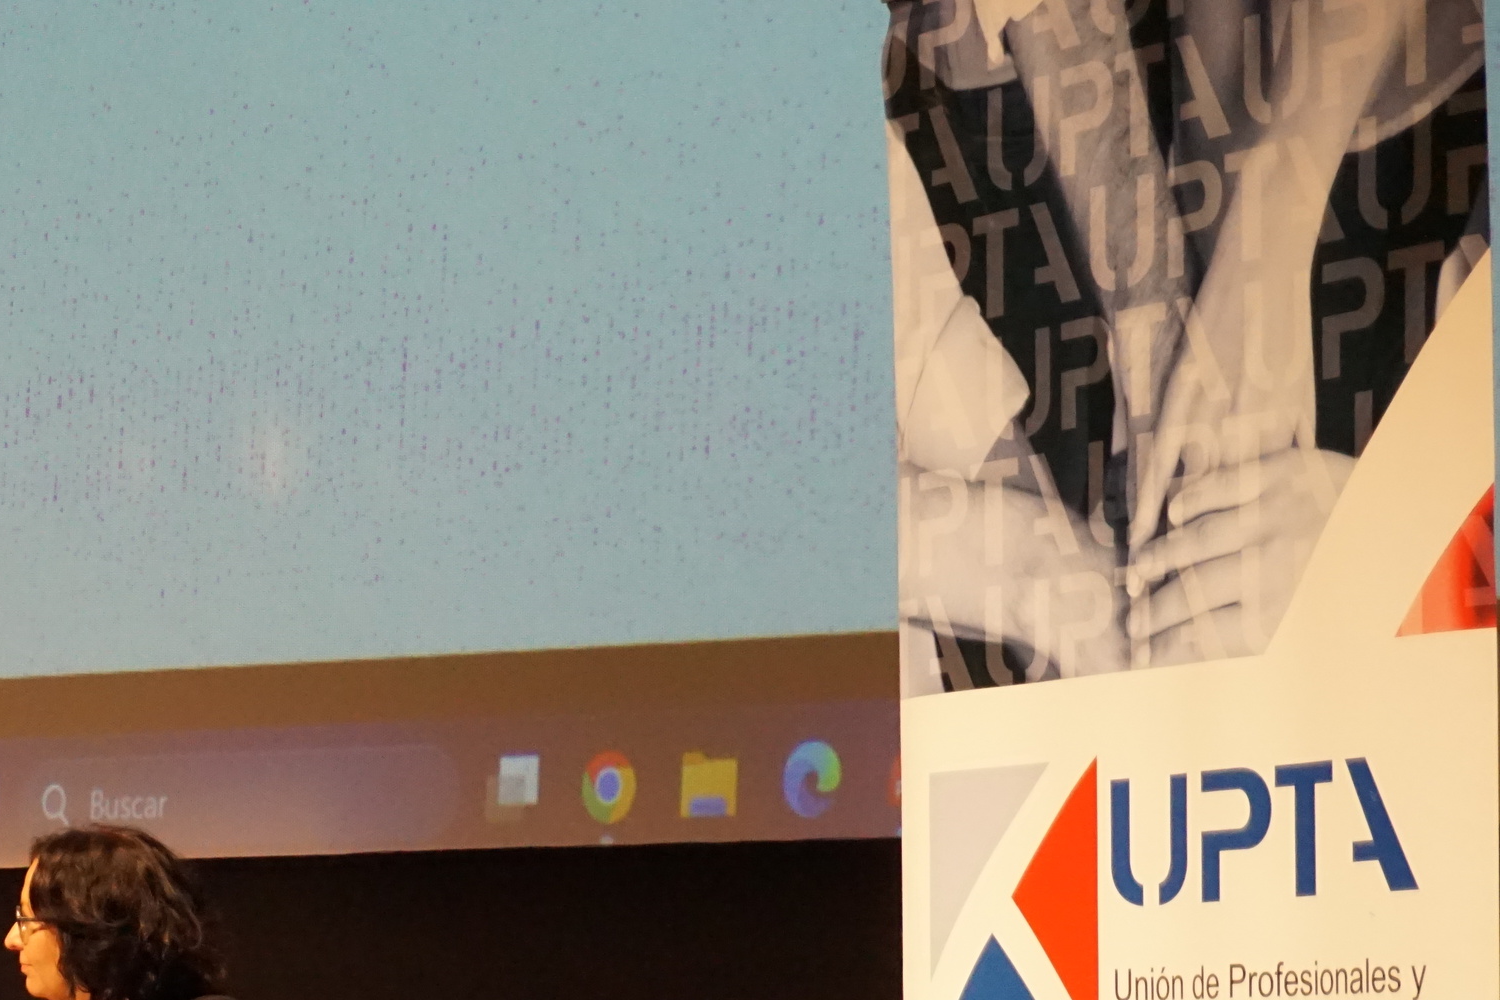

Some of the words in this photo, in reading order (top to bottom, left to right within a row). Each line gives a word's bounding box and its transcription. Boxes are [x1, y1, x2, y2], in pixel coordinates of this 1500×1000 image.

[89, 788, 169, 821] Buscar
[1109, 756, 1420, 907] UPTA
[1191, 964, 1220, 1000] de
[1229, 957, 1402, 999] Profesionales
